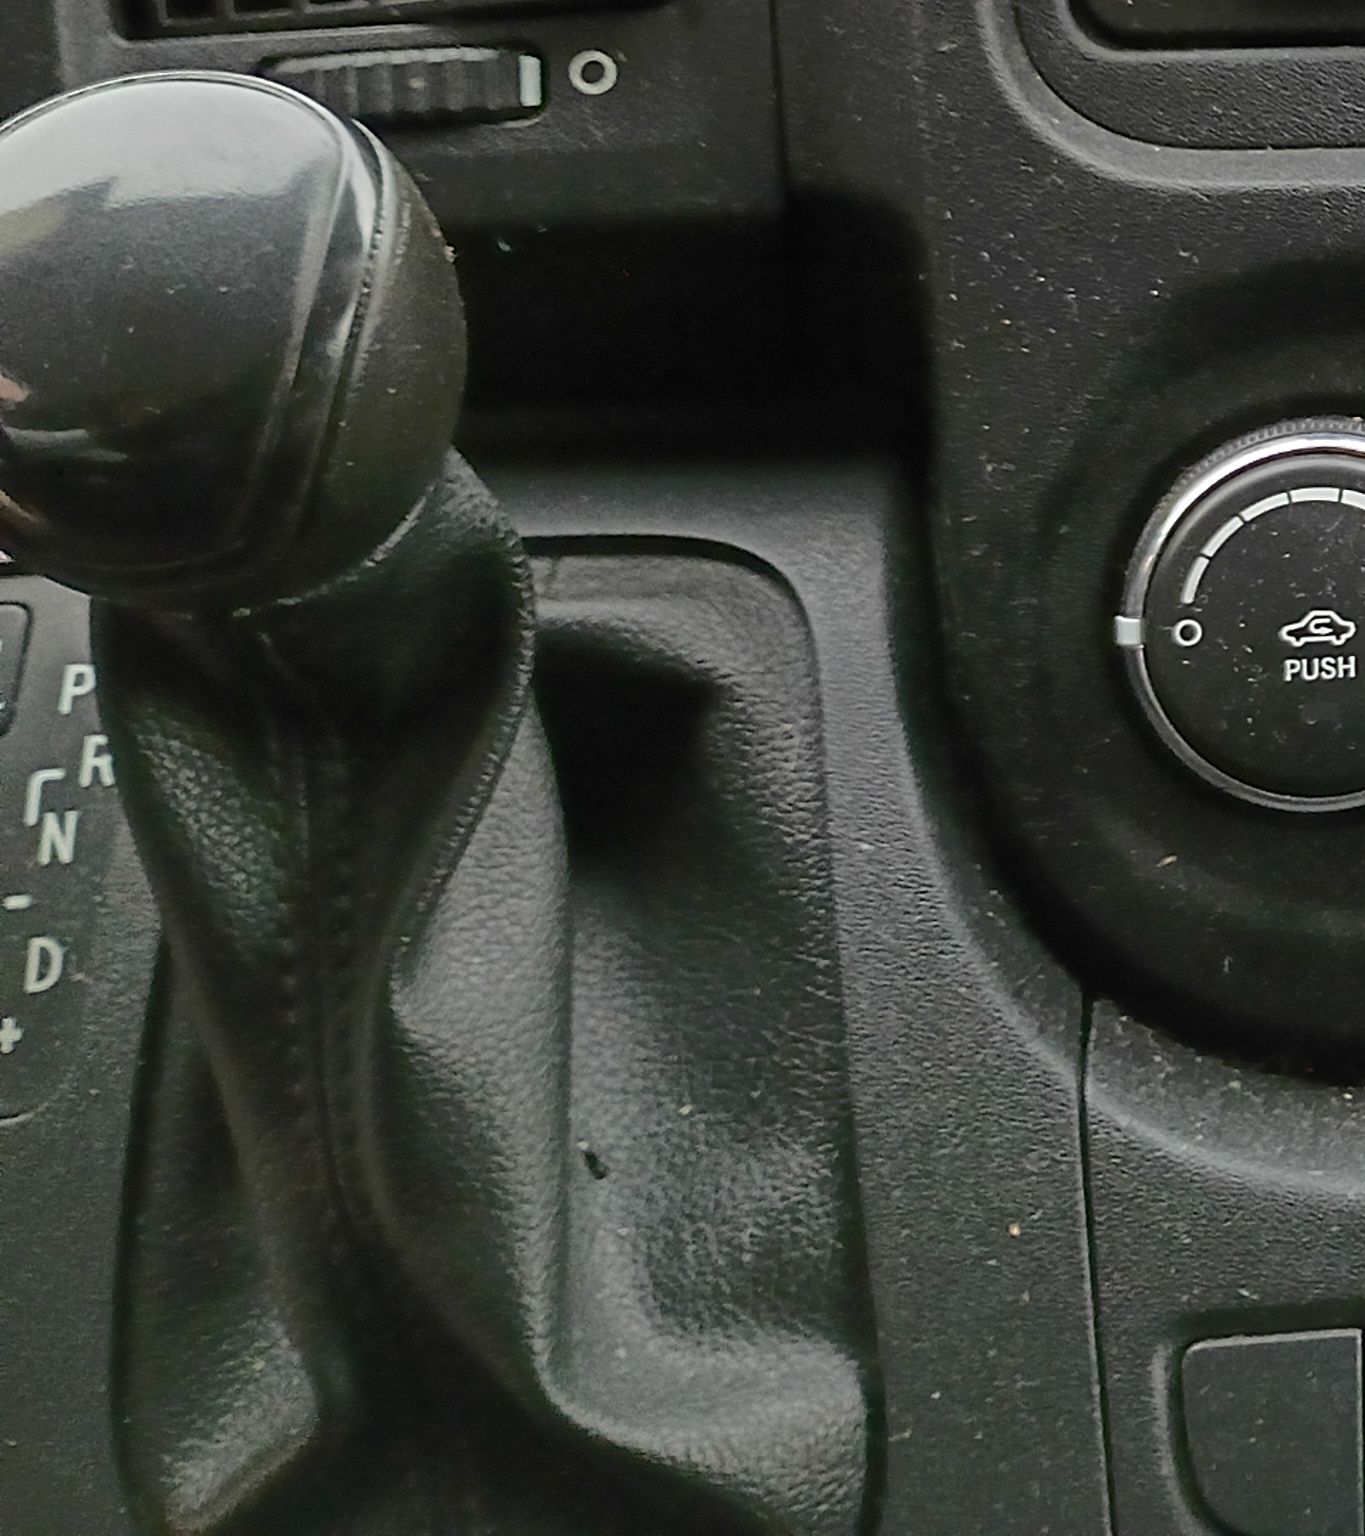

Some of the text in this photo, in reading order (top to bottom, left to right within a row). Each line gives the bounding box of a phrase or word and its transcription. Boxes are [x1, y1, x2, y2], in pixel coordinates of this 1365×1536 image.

[59, 663, 95, 714] P
[1284, 655, 1356, 682] PUSH
[38, 810, 79, 865] N
[24, 937, 64, 993] D
